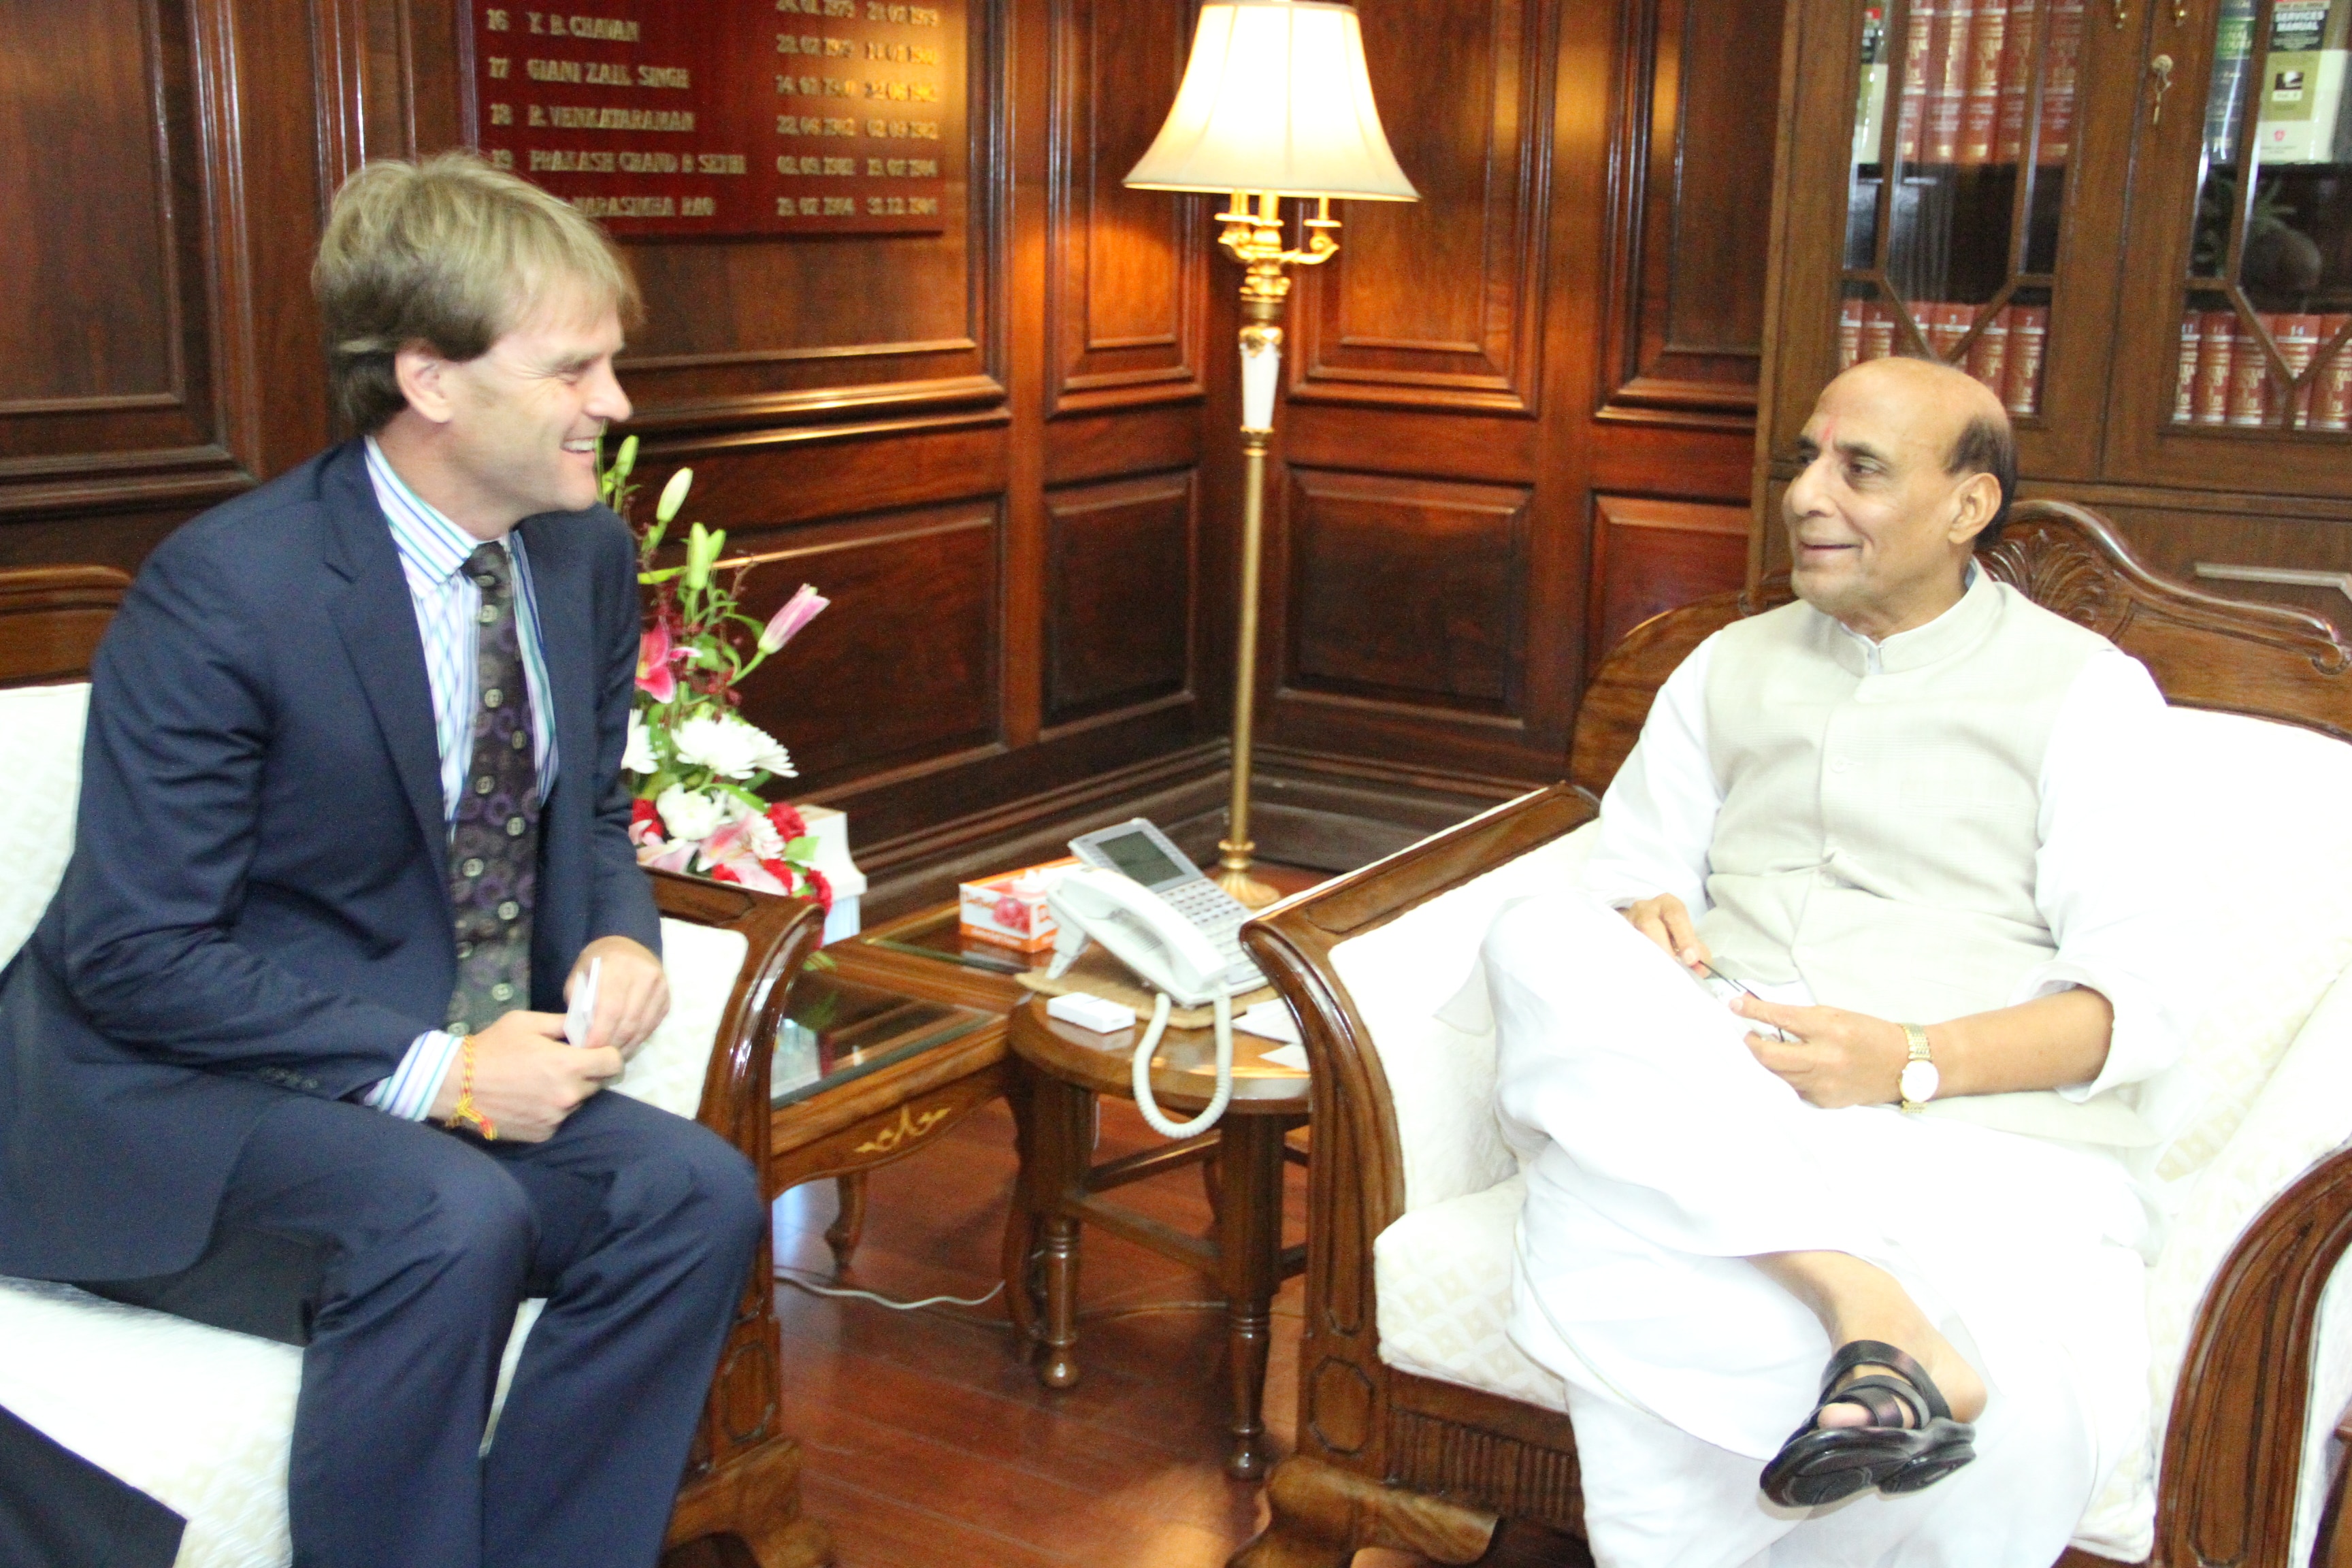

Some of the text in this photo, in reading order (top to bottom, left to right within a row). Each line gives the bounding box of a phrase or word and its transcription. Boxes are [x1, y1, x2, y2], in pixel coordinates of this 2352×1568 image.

[487, 8, 510, 31] 16
[570, 16, 640, 42] CHAVAN
[488, 56, 510, 79] 17
[638, 65, 690, 89] SINGH
[681, 197, 715, 216] RAO
